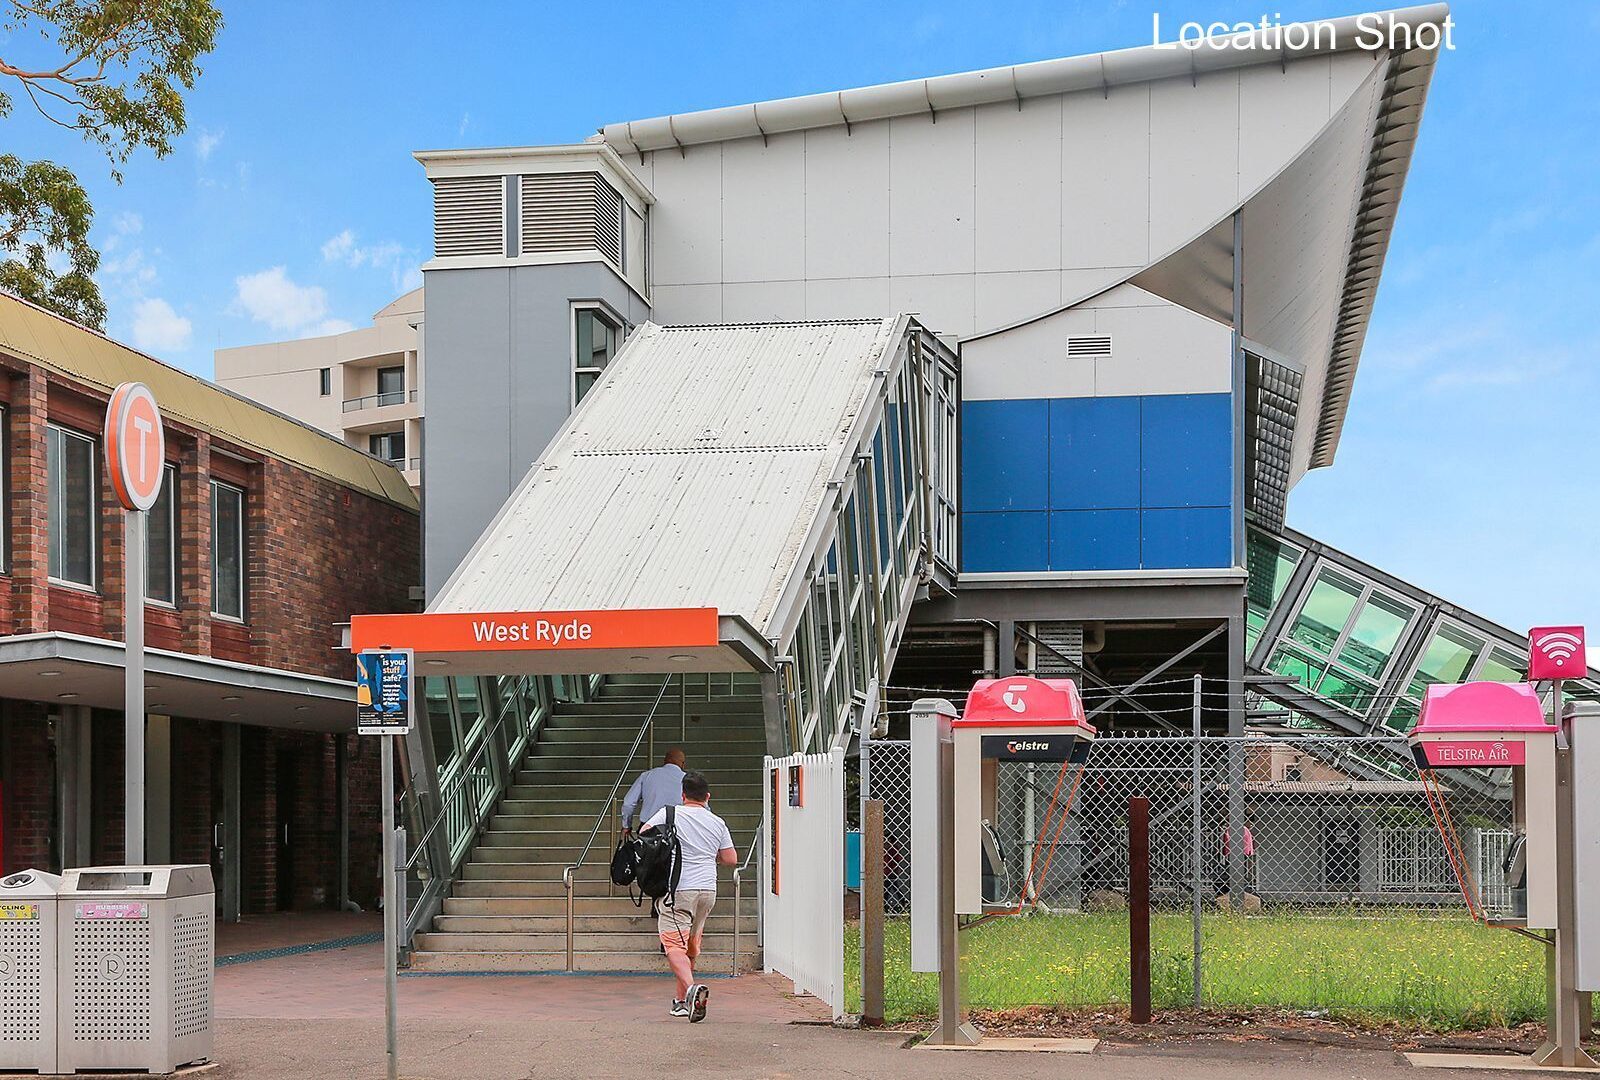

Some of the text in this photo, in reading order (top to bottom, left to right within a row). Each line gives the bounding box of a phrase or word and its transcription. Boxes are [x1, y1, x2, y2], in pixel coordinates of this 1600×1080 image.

[135, 416, 151, 483] T
[473, 619, 592, 645] West Ryde
[390, 659, 406, 668] your
[382, 666, 400, 674] stuff
[382, 674, 402, 682] safe?
[1006, 741, 1049, 753] Telstra
[1437, 748, 1485, 760] TELSTRA
